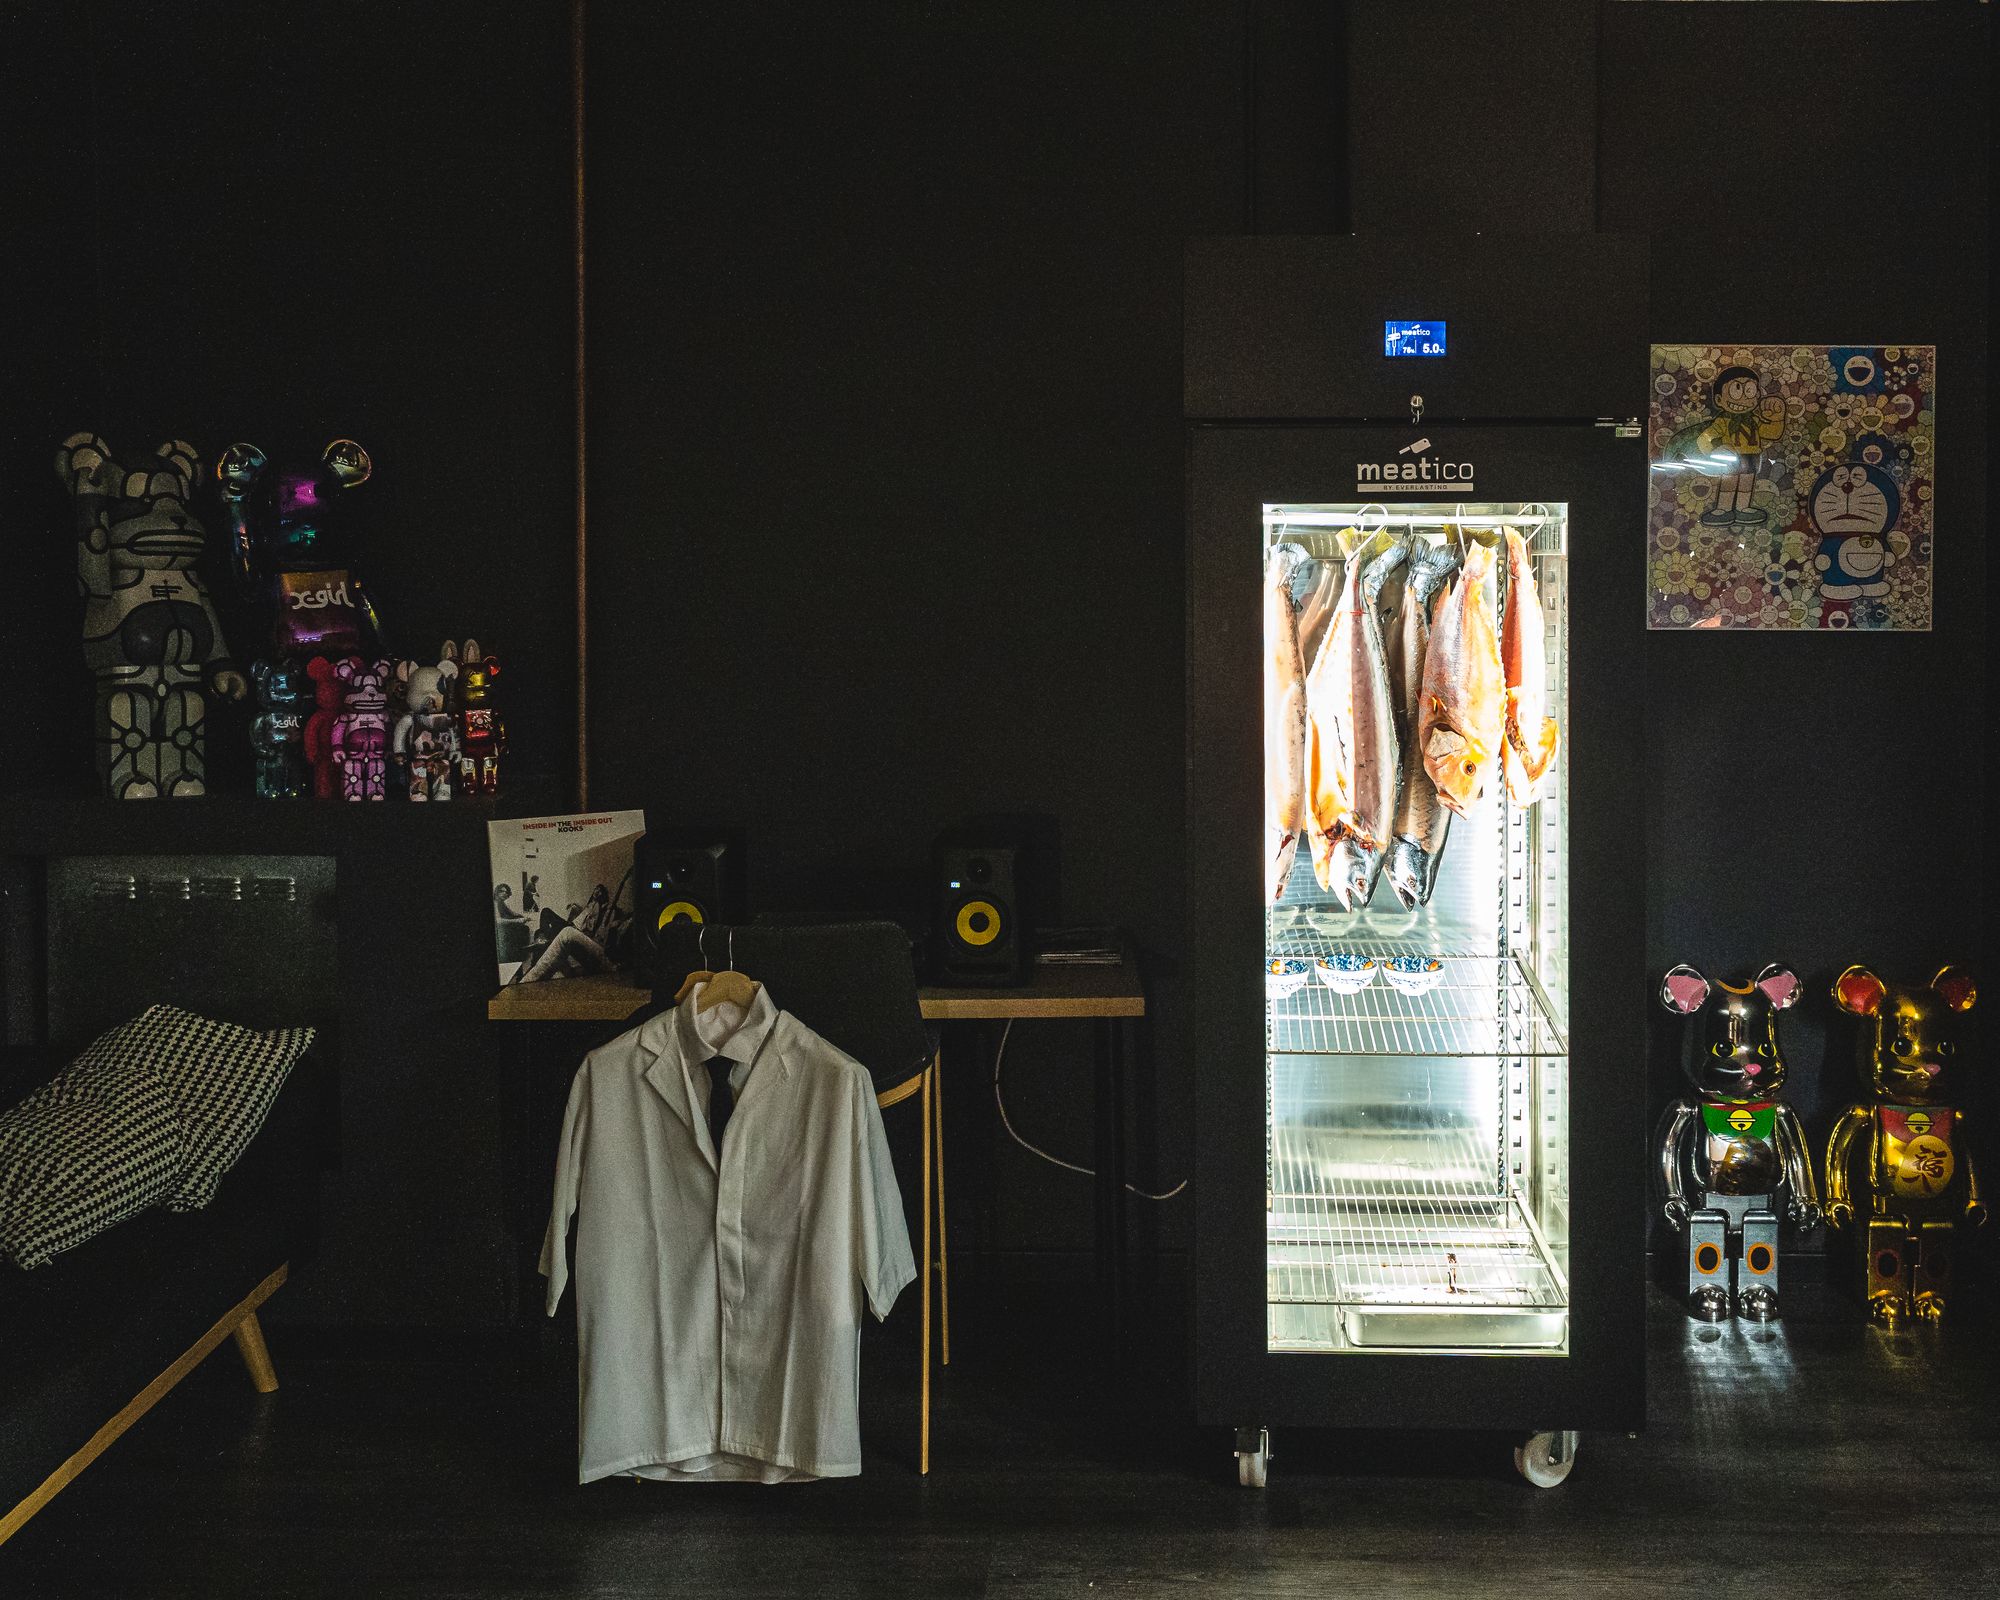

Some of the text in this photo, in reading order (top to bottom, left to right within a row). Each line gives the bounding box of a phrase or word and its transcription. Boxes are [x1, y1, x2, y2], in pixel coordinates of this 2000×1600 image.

[1401, 328, 1431, 336] meatico
[1356, 457, 1474, 481] meatico
[522, 823, 548, 831] INSIDE
[557, 820, 572, 828] THE
[573, 818, 597, 827] INSIDE
[557, 825, 584, 833] KOOKS
